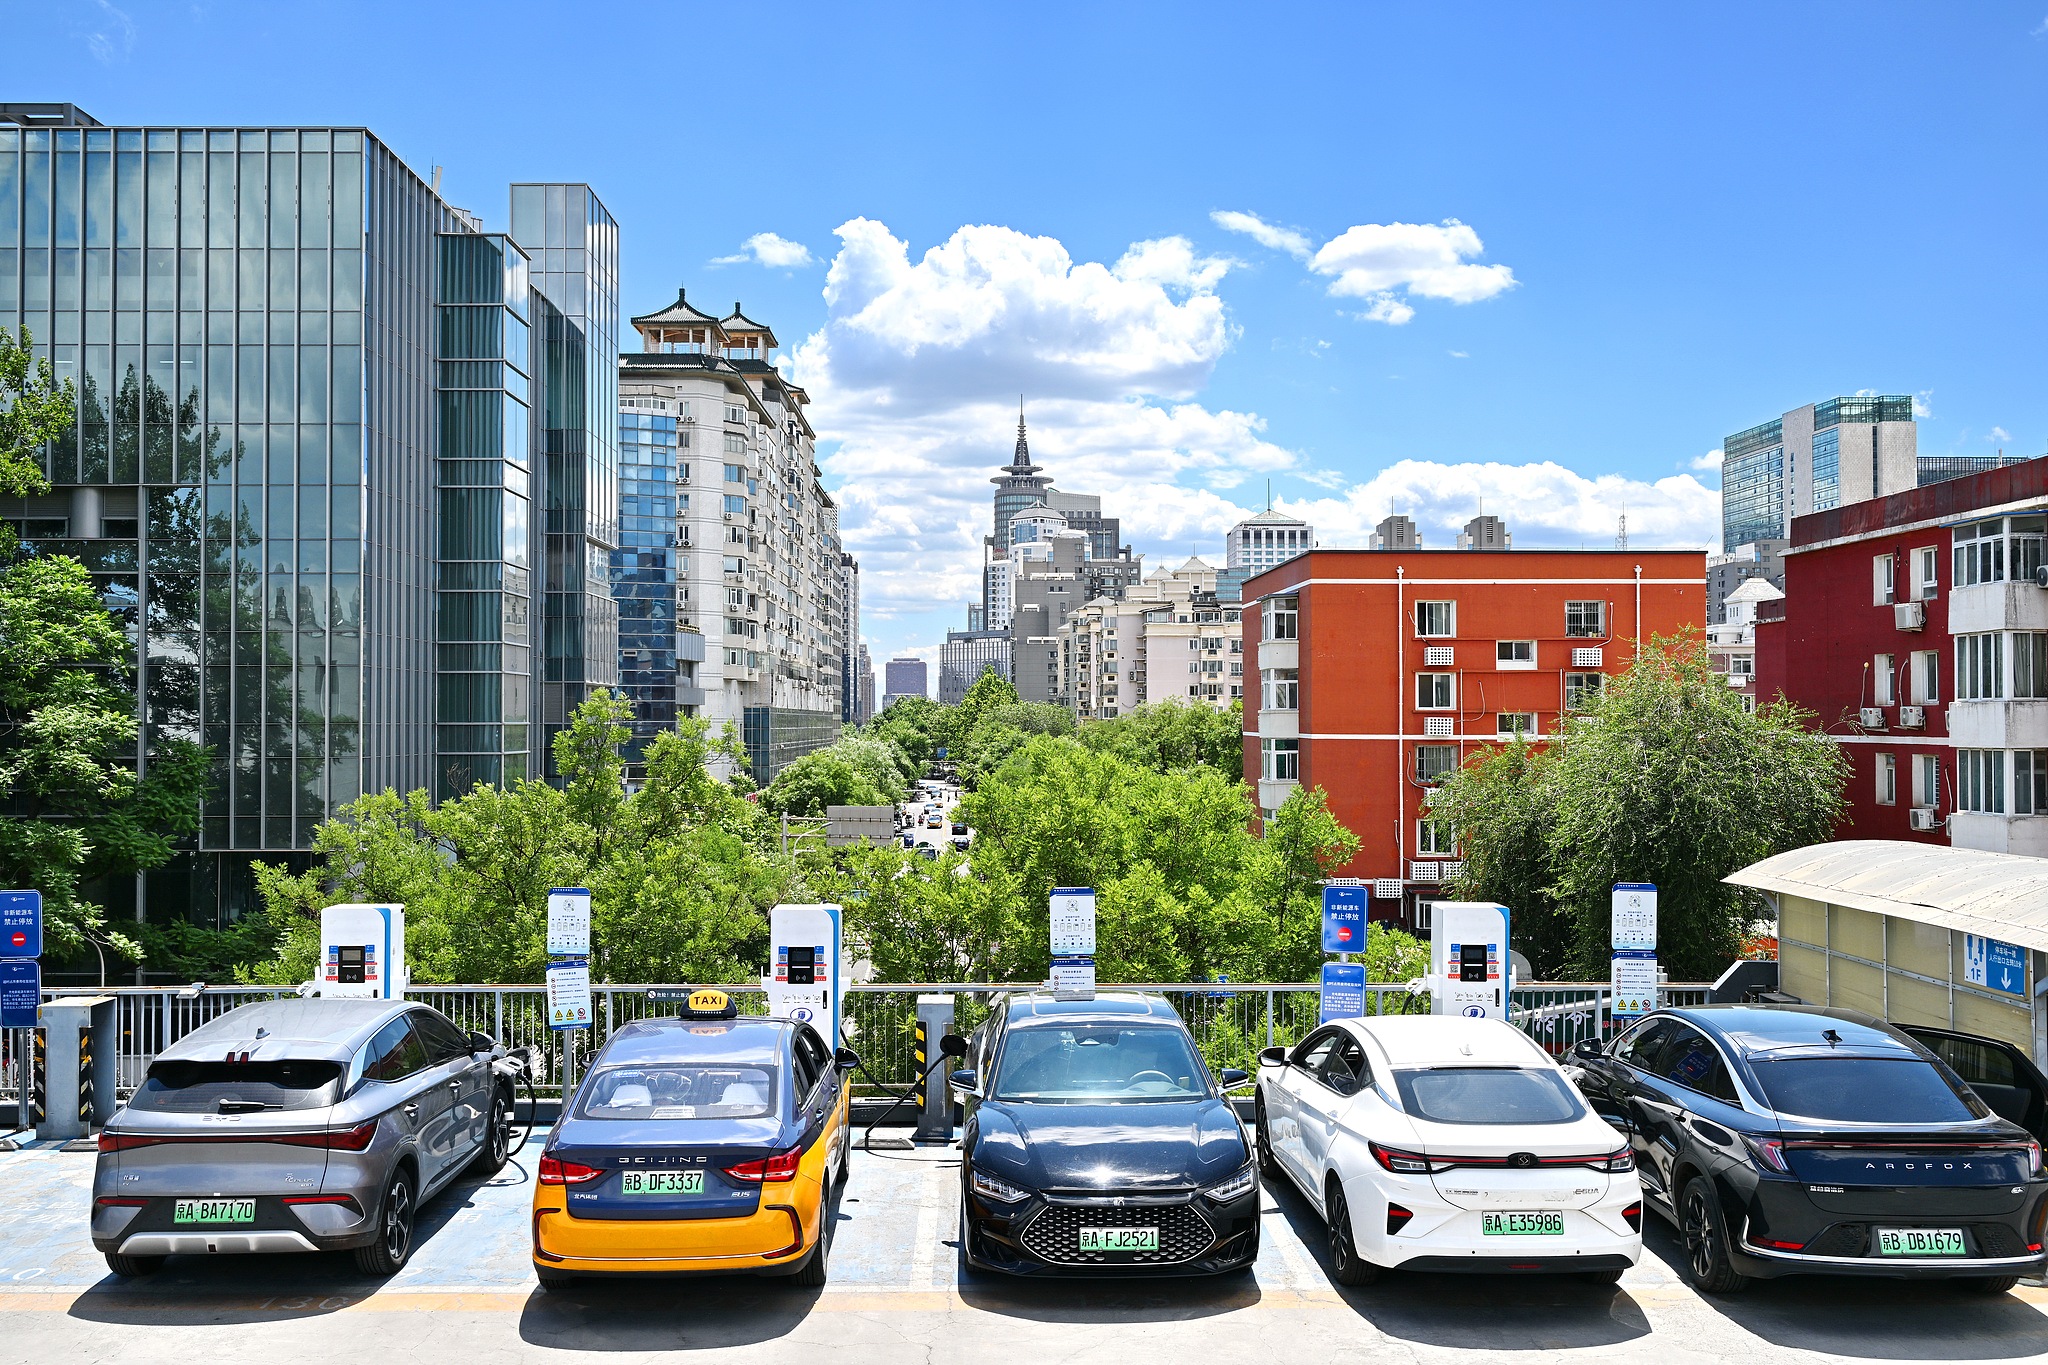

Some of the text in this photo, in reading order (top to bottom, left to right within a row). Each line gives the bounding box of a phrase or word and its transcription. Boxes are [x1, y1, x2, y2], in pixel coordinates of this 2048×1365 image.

[1331, 912, 1360, 921] 禁止停放
[4, 917, 34, 926] 禁止停放
[1970, 967, 1982, 981] 1F
[694, 996, 722, 1005] TAXI
[1865, 1162, 1973, 1170] ARCFOX
